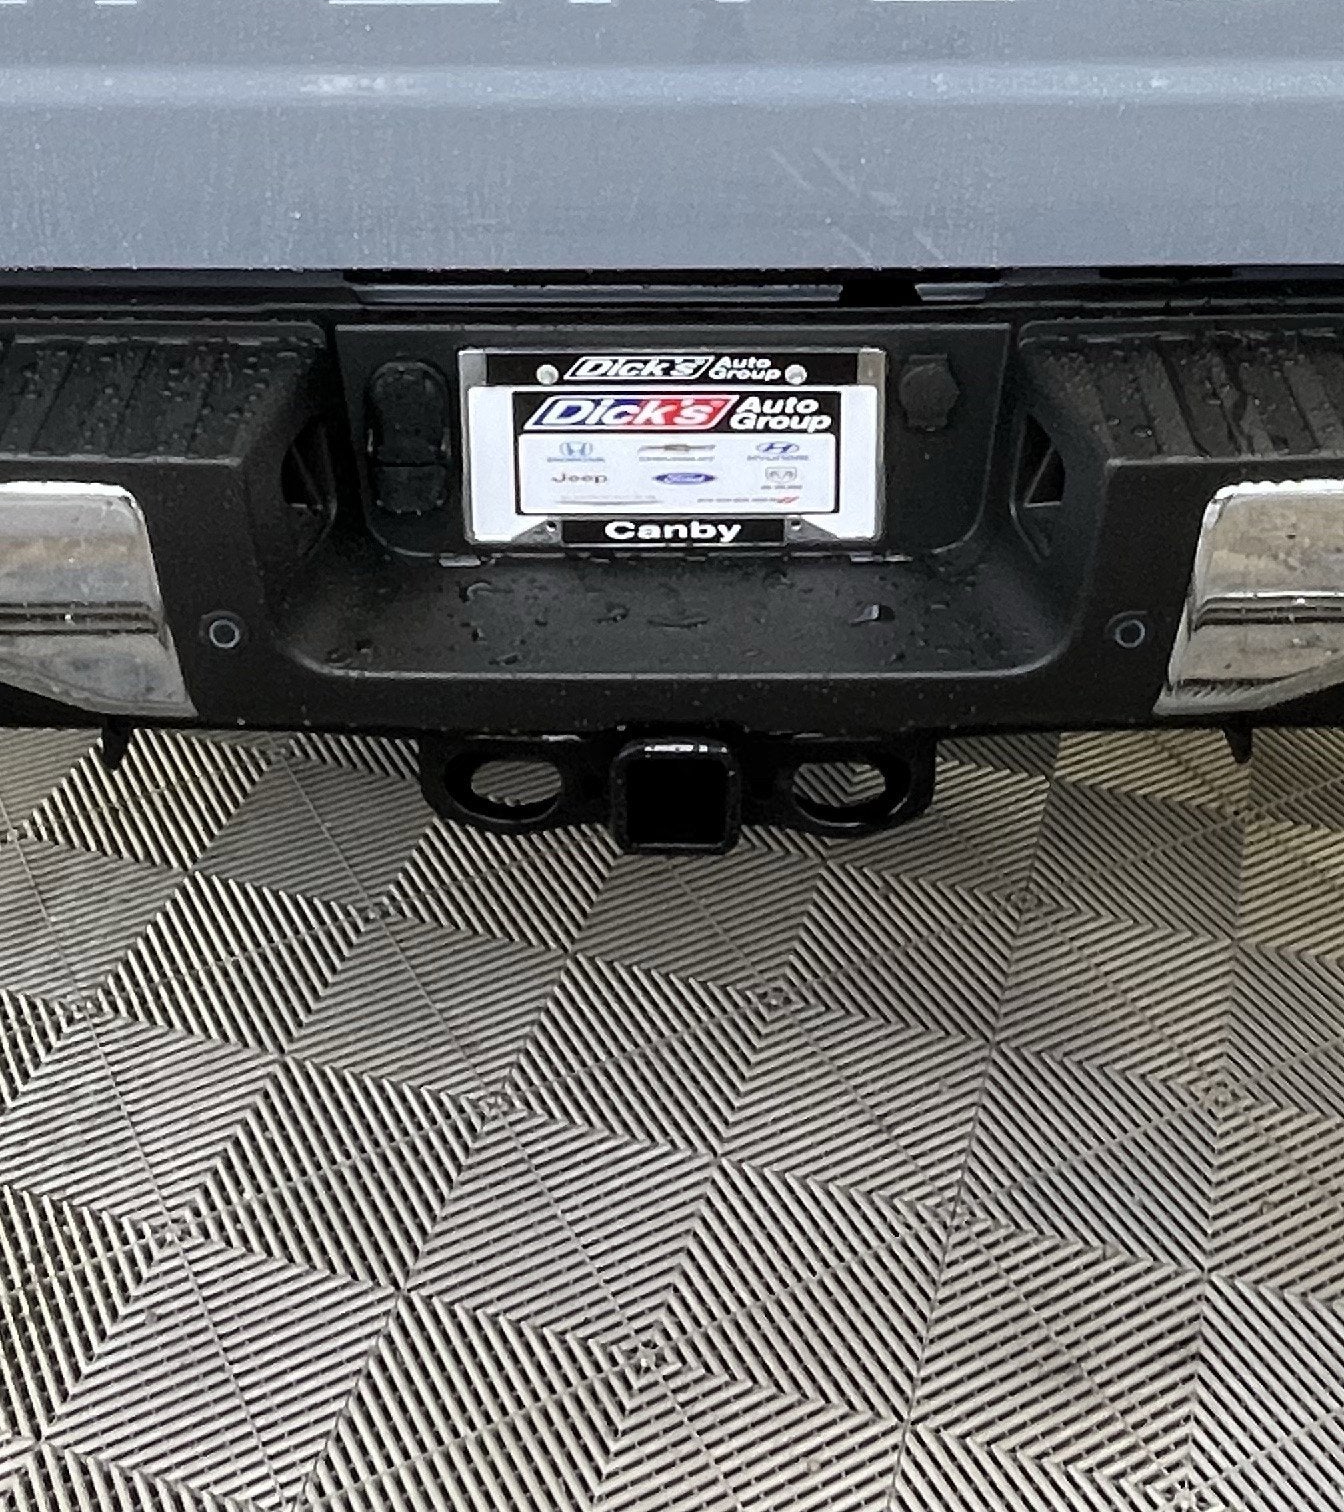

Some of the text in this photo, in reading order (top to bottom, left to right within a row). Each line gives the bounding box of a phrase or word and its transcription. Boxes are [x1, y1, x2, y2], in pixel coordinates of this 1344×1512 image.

[713, 356, 772, 368] Auto
[708, 368, 782, 381] Group
[736, 397, 820, 414] Auto
[729, 413, 832, 433] Group
[604, 521, 742, 543] Canby
